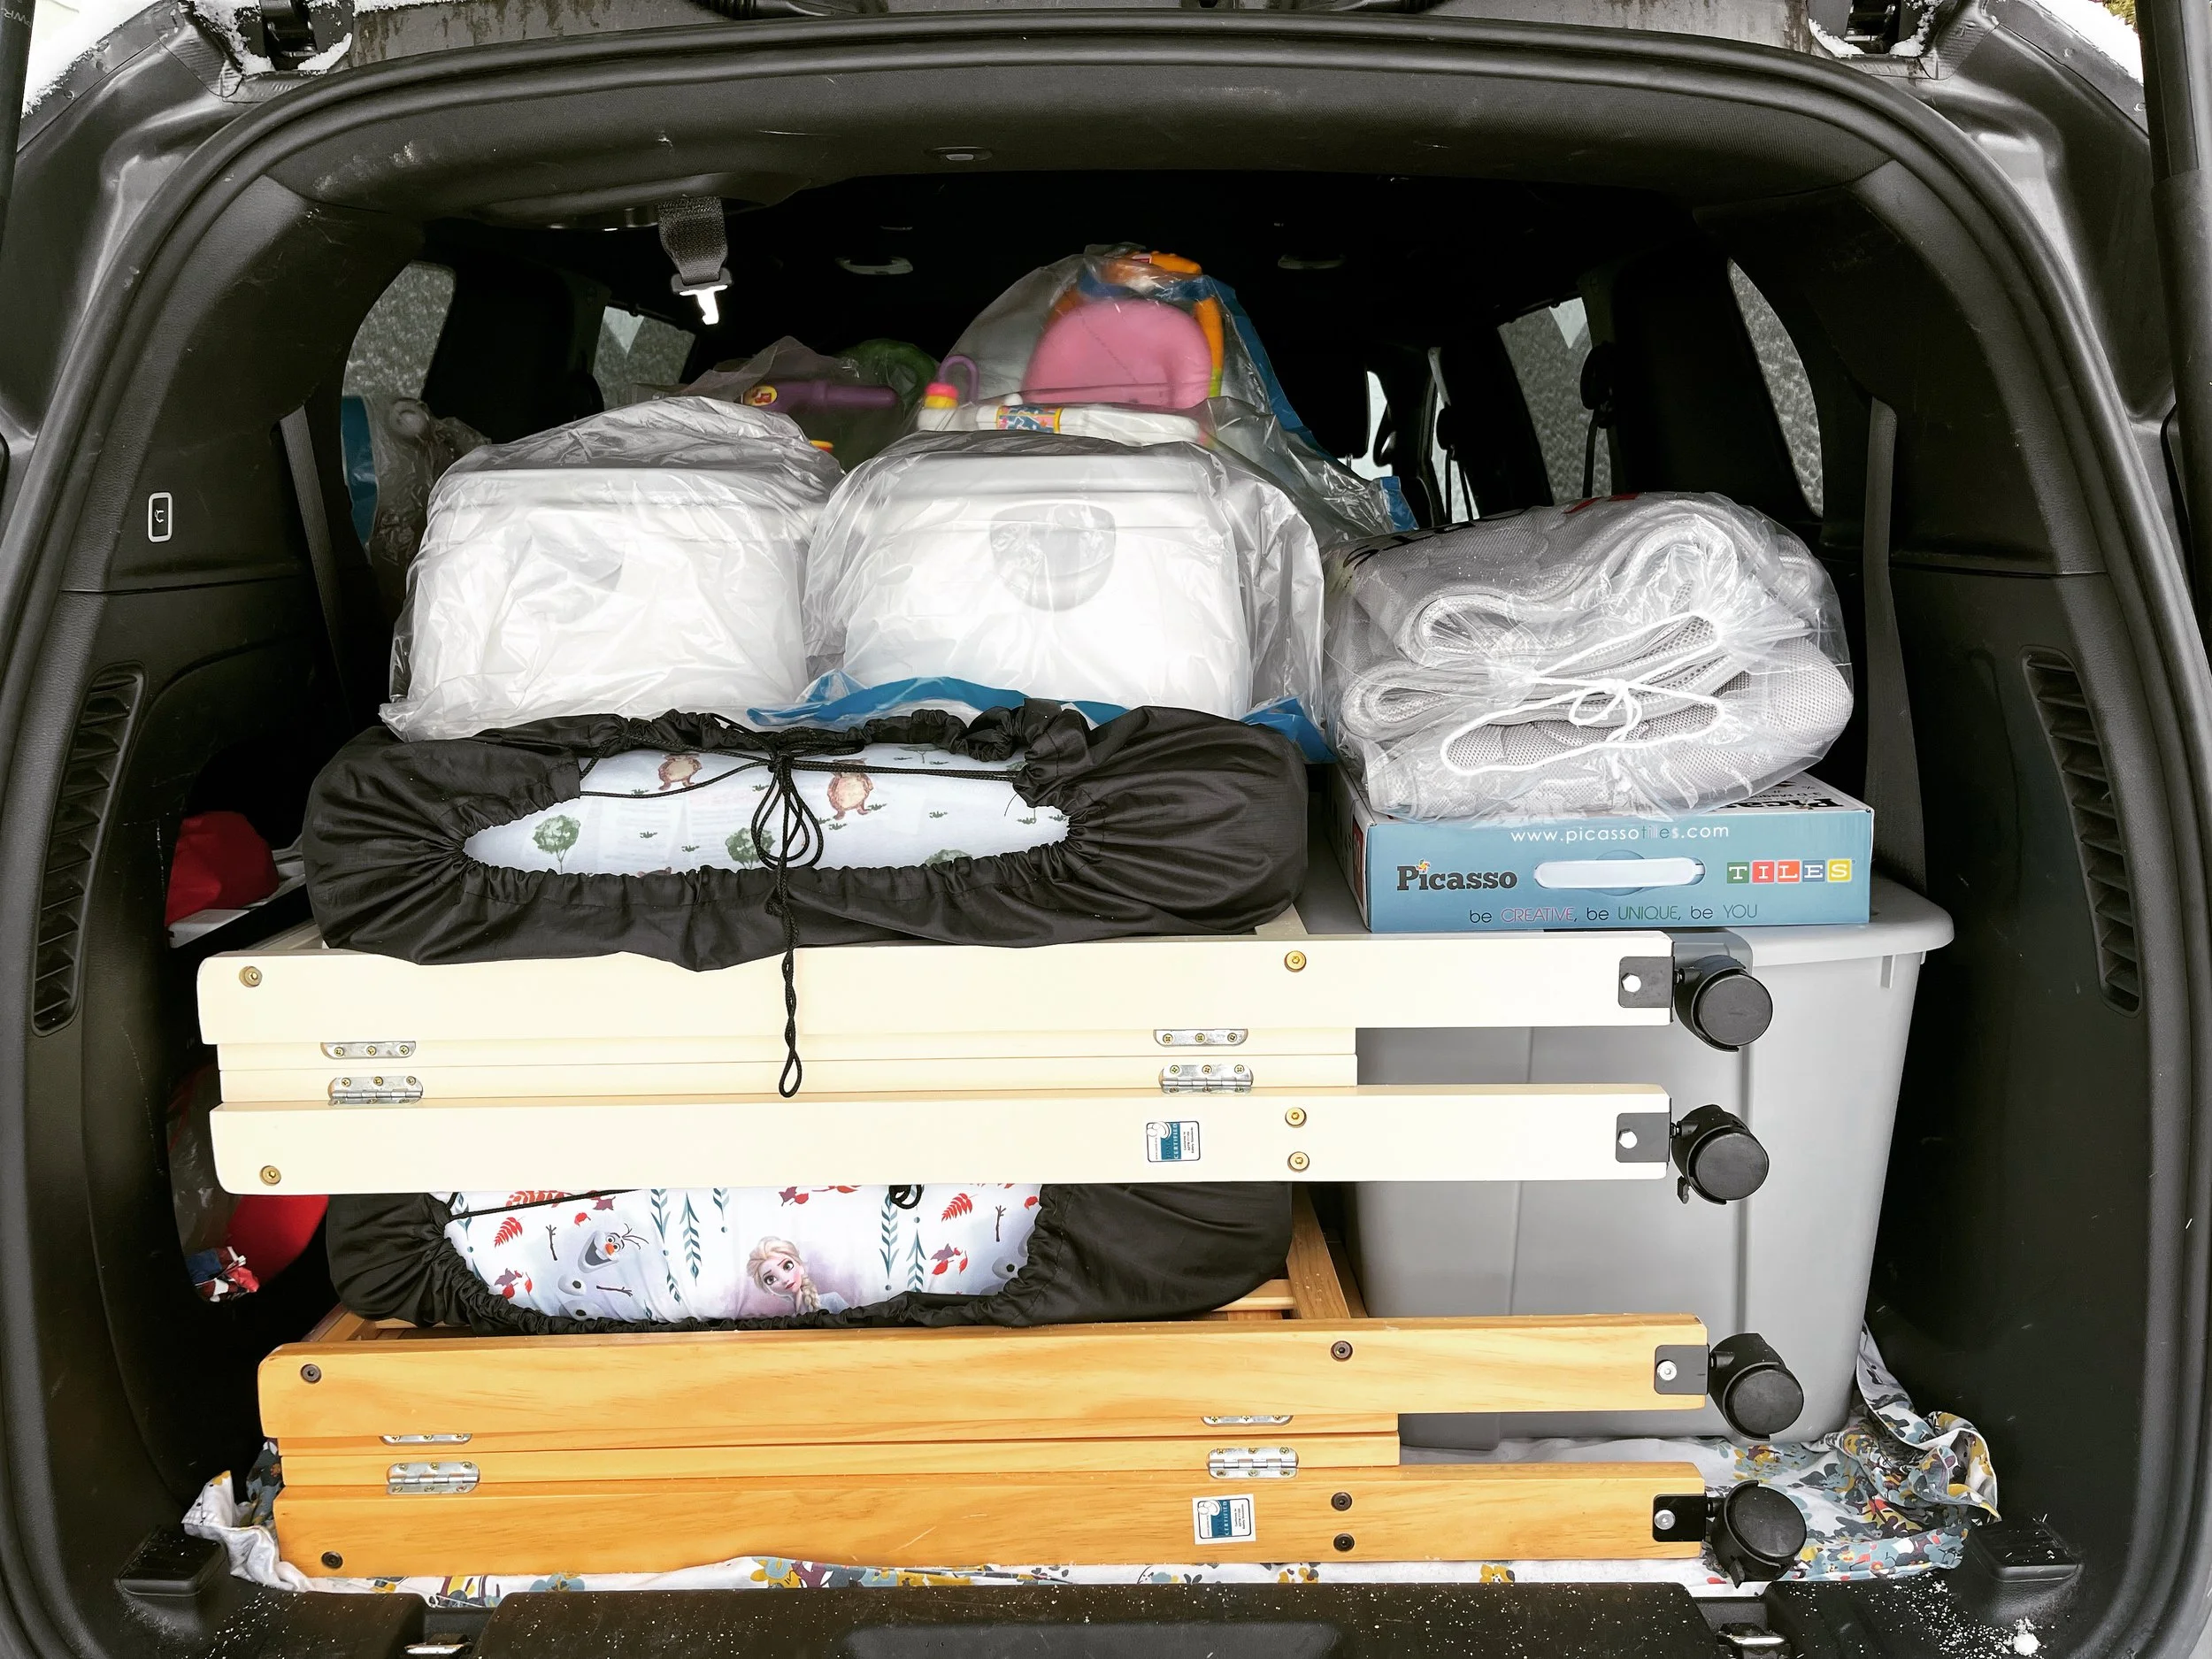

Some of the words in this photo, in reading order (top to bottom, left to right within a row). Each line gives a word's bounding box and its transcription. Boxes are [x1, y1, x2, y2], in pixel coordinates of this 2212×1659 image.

[1396, 864, 1518, 891] Picasso
[1728, 864, 1848, 880] TILES
[1469, 910, 1493, 924] be
[1501, 907, 1578, 923] CREATIVE,
[1586, 907, 1609, 921] be
[1617, 905, 1682, 921] UNIQUE,
[1690, 905, 1714, 919] be
[1723, 903, 1758, 918] YOU
